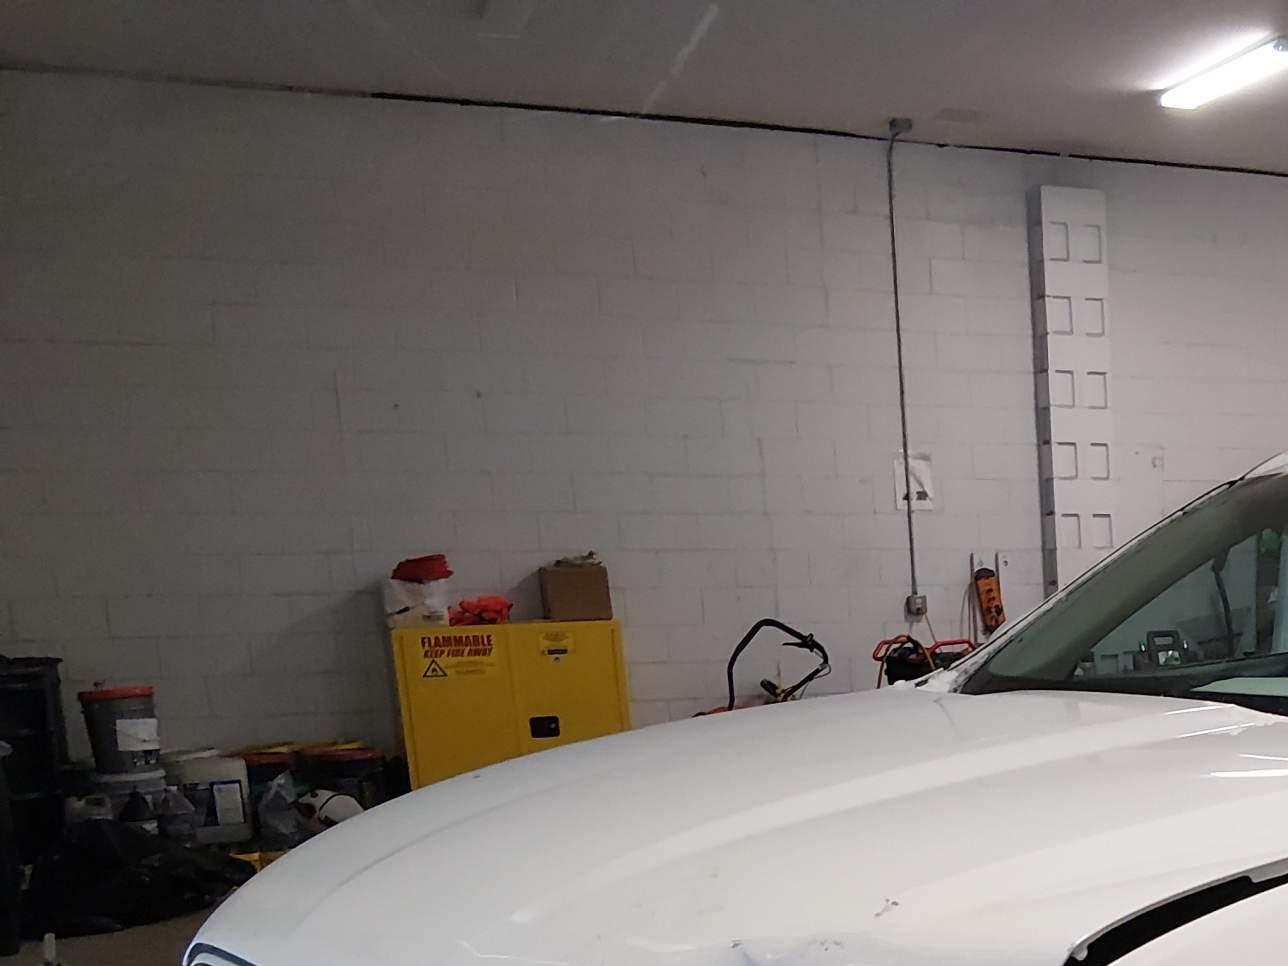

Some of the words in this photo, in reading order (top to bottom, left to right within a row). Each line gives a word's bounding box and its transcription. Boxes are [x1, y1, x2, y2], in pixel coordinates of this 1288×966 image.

[421, 634, 493, 648] FLAMMABLE
[424, 649, 446, 658] KEEP
[467, 647, 493, 656] AWAY
